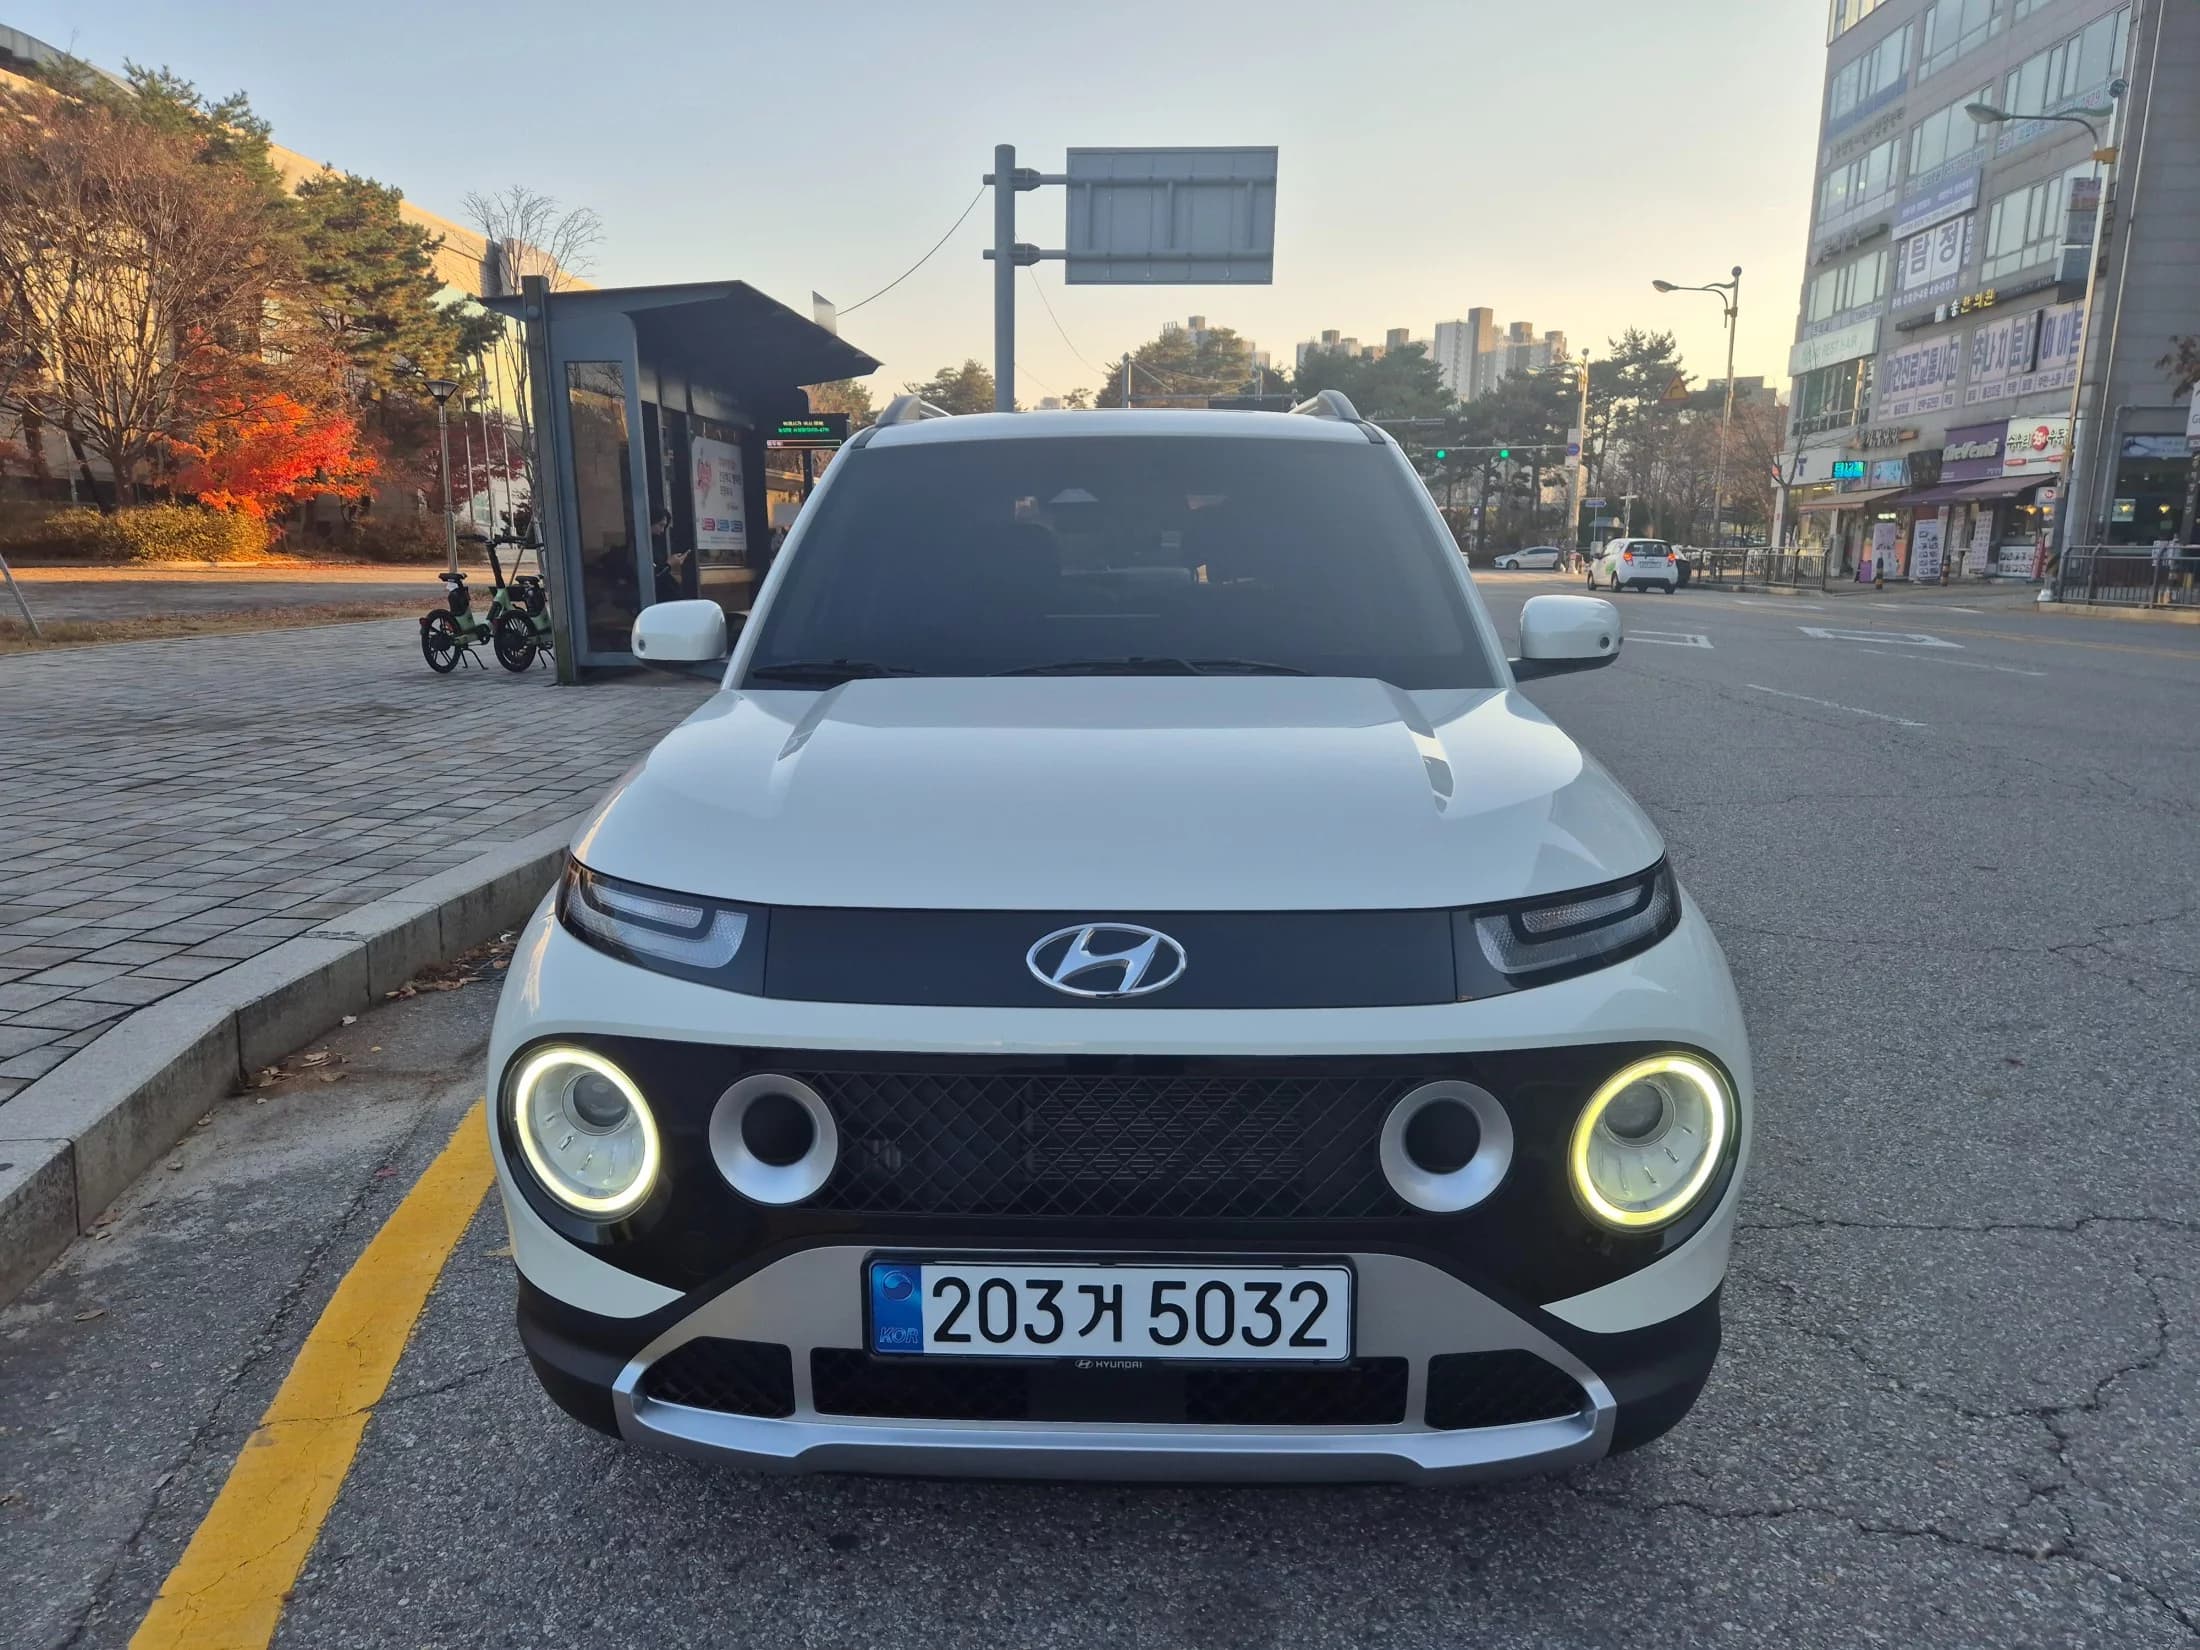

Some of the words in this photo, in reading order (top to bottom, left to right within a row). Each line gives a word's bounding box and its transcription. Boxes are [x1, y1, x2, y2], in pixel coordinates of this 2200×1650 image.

[1910, 221, 1960, 275] 탐정
[932, 1277, 1122, 1344] 203거
[1148, 1280, 1328, 1347] 5032
[880, 1327, 919, 1344] KOR
[1095, 1361, 1143, 1369] HYUNDAI
